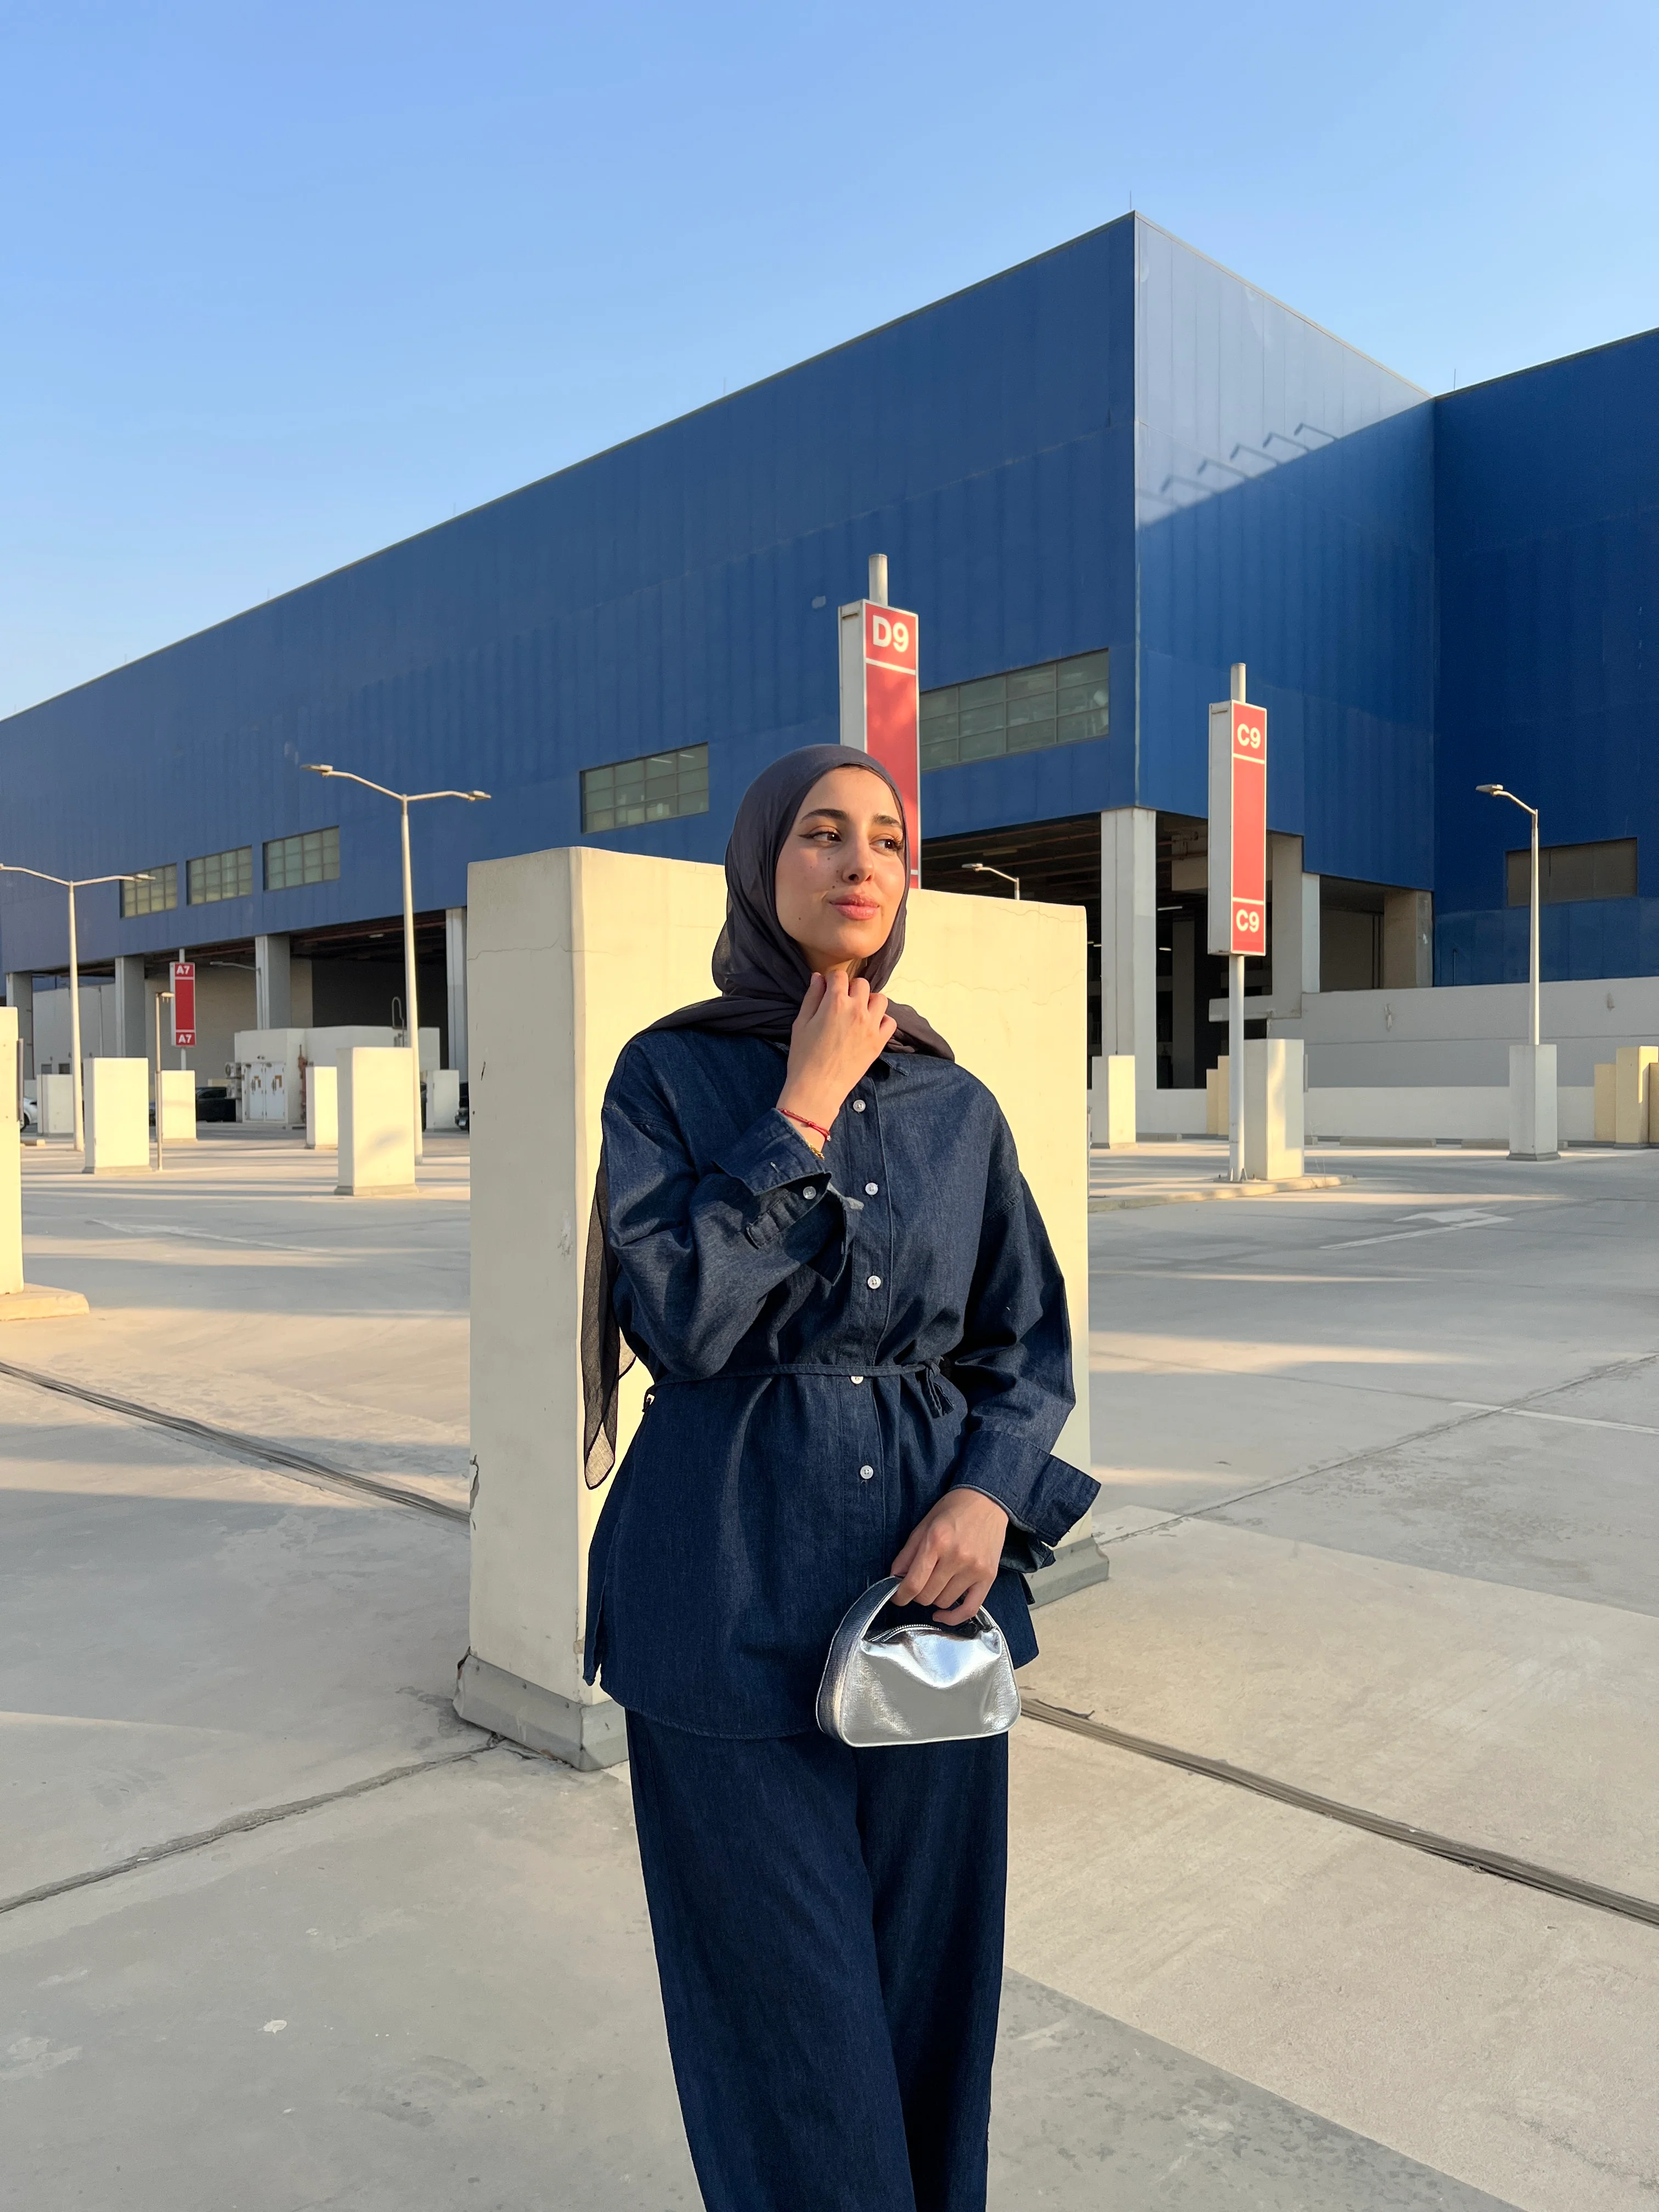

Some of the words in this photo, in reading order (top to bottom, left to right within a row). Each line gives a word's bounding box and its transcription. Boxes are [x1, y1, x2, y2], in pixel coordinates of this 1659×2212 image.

[872, 614, 909, 652] D9
[1237, 723, 1261, 749] C9
[1236, 909, 1259, 933] C9
[176, 964, 190, 975] A7
[178, 1034, 192, 1044] A7
